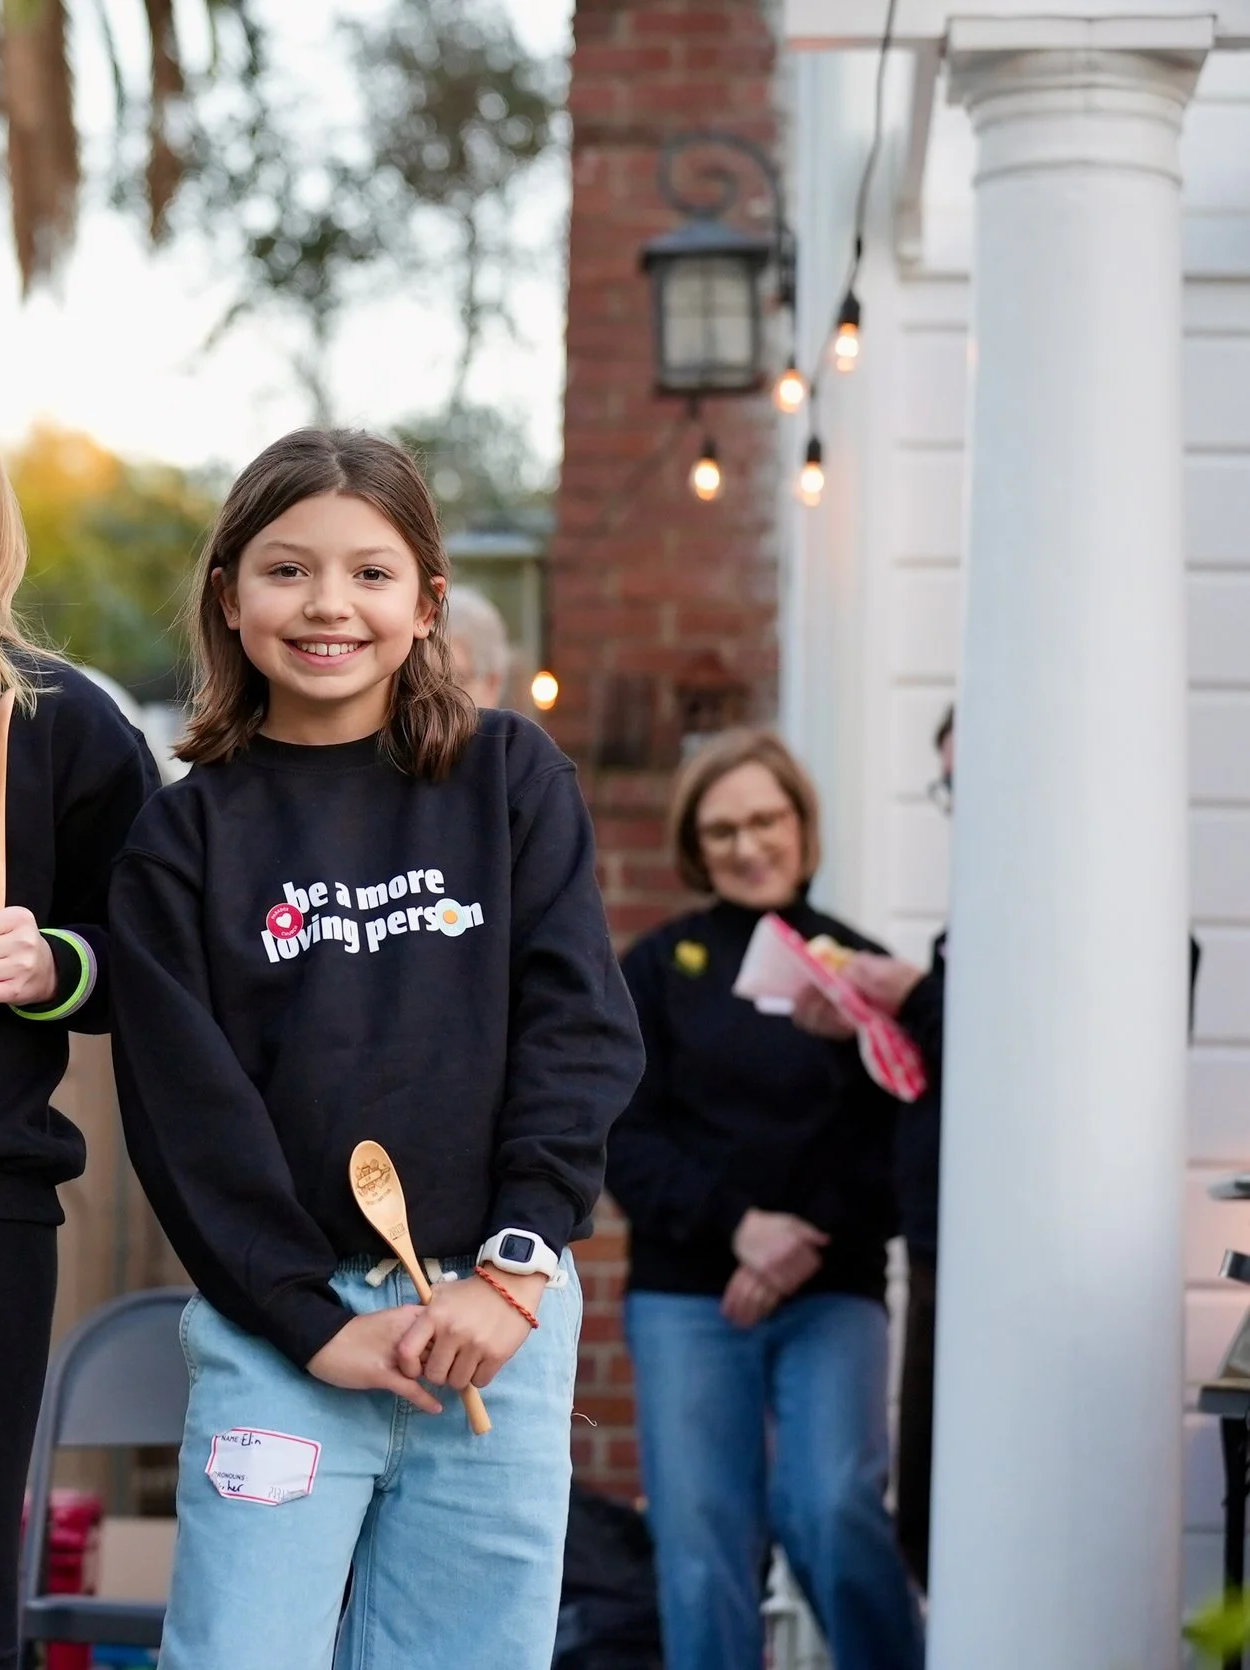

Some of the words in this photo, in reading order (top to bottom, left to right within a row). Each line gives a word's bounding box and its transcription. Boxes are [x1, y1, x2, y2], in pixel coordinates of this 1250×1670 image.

[283, 881, 329, 914] be
[334, 881, 352, 909] a
[355, 868, 445, 910] more
[260, 913, 361, 963] loving
